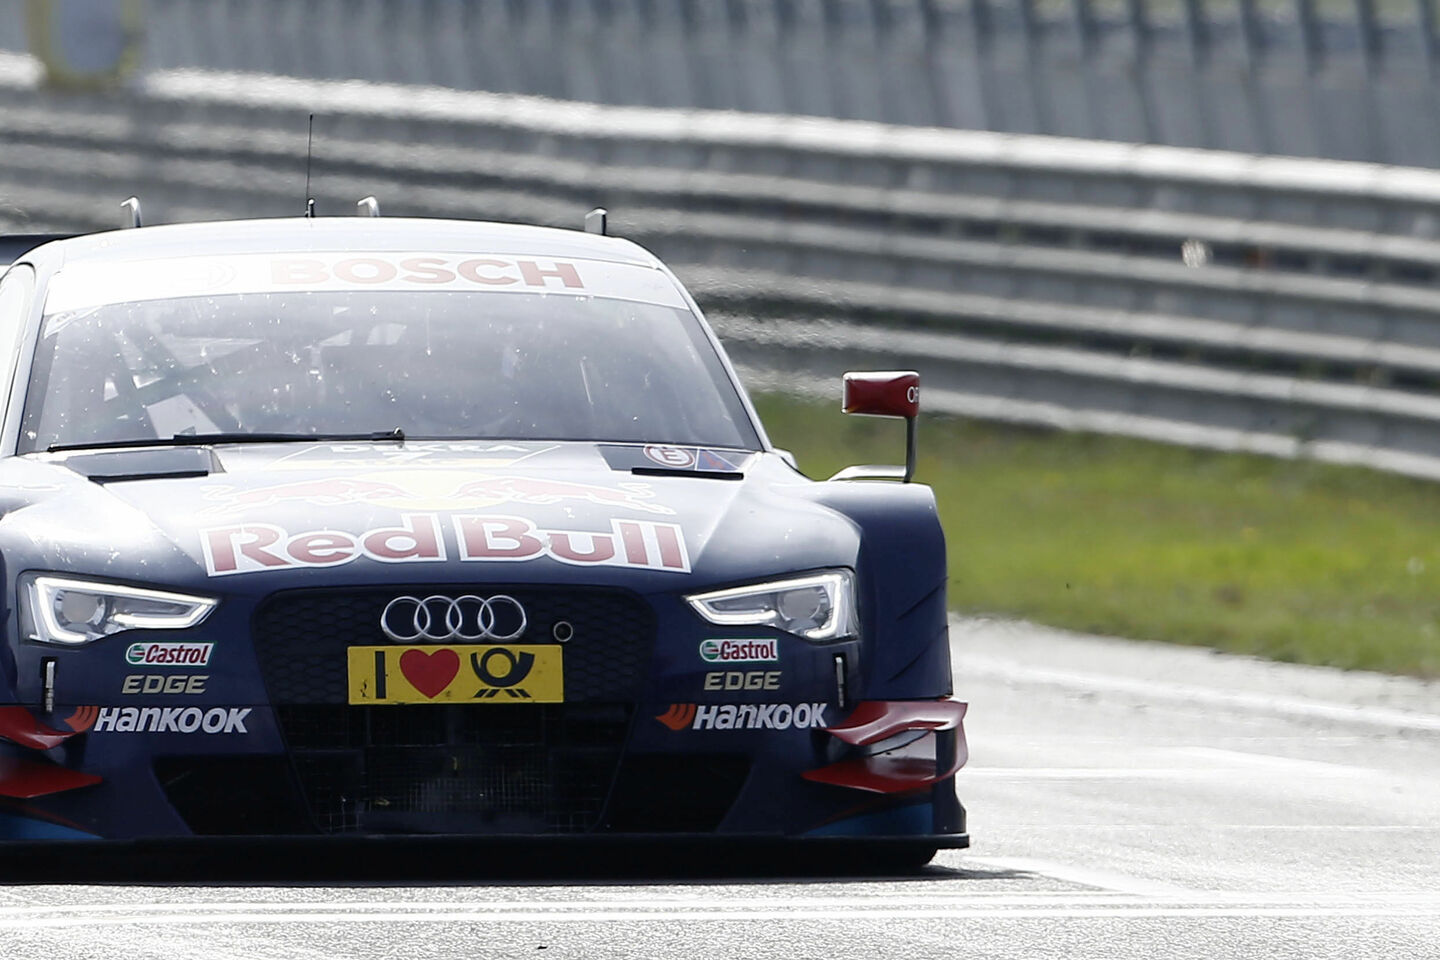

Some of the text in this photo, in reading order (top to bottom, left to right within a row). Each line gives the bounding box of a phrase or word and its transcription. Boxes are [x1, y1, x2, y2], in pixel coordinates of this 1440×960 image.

[270, 257, 586, 290] BOSCH
[205, 514, 686, 575] Red Bull
[145, 644, 209, 664] Castrol
[720, 640, 777, 660] Castrol
[122, 675, 210, 694] EDGE
[374, 650, 386, 699] I
[703, 671, 782, 690] EDGE
